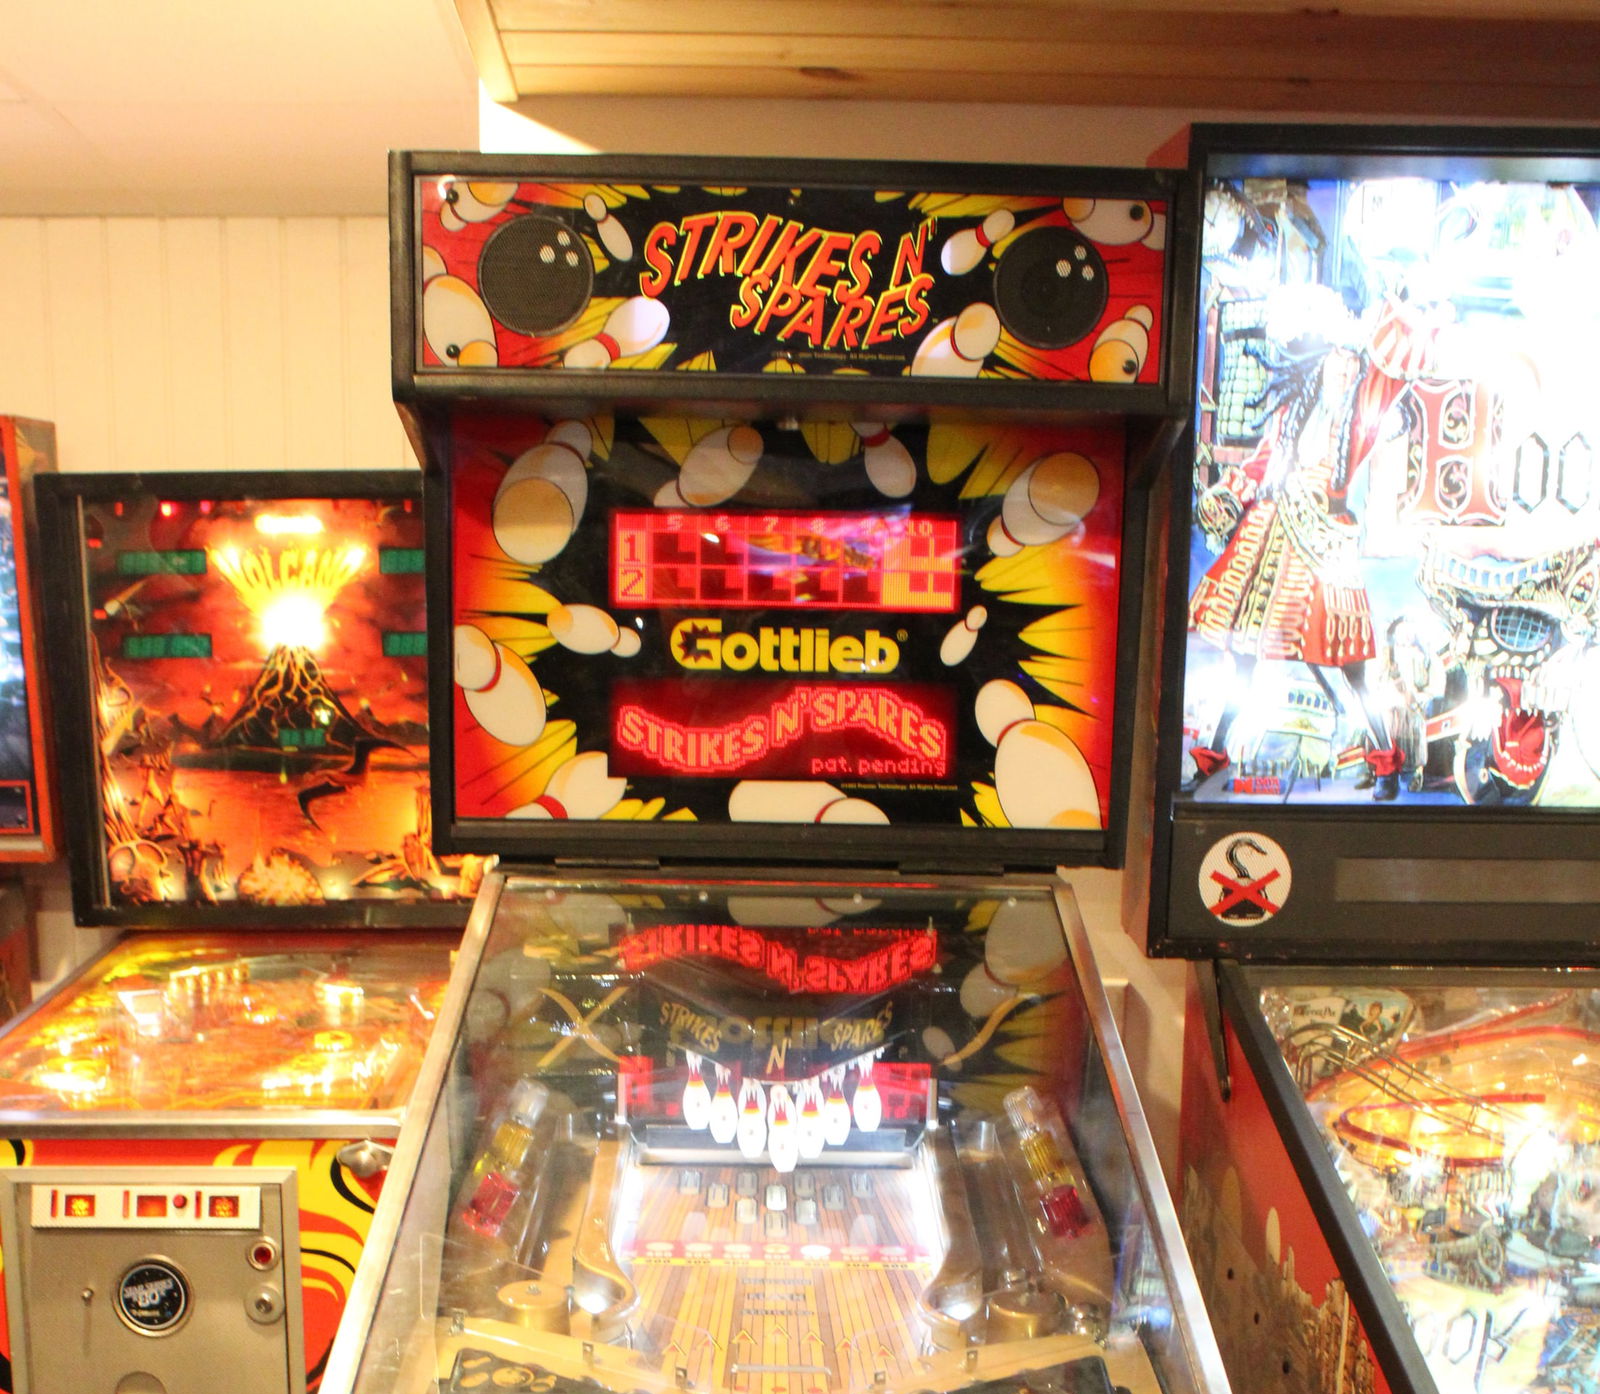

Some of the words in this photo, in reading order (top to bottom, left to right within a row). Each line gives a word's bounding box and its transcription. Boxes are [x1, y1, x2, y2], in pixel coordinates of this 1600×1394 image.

[639, 210, 882, 304] STRIKES
[730, 273, 935, 350] SPARES
[1396, 377, 1600, 527] Hoo
[623, 532, 640, 563] 1
[666, 515, 683, 531] 5
[714, 516, 731, 532] 6
[763, 517, 779, 532] 7
[810, 517, 826, 534] 8
[905, 519, 932, 536] 10
[205, 540, 369, 590] VOLCANO
[621, 568, 644, 598] 2
[617, 705, 769, 773] STRIKES
[811, 687, 946, 760] SPARES
[811, 756, 853, 774] pat.
[858, 758, 946, 777] pending
[660, 1001, 722, 1053] STRIKES
[831, 1001, 893, 1051] SPARES
